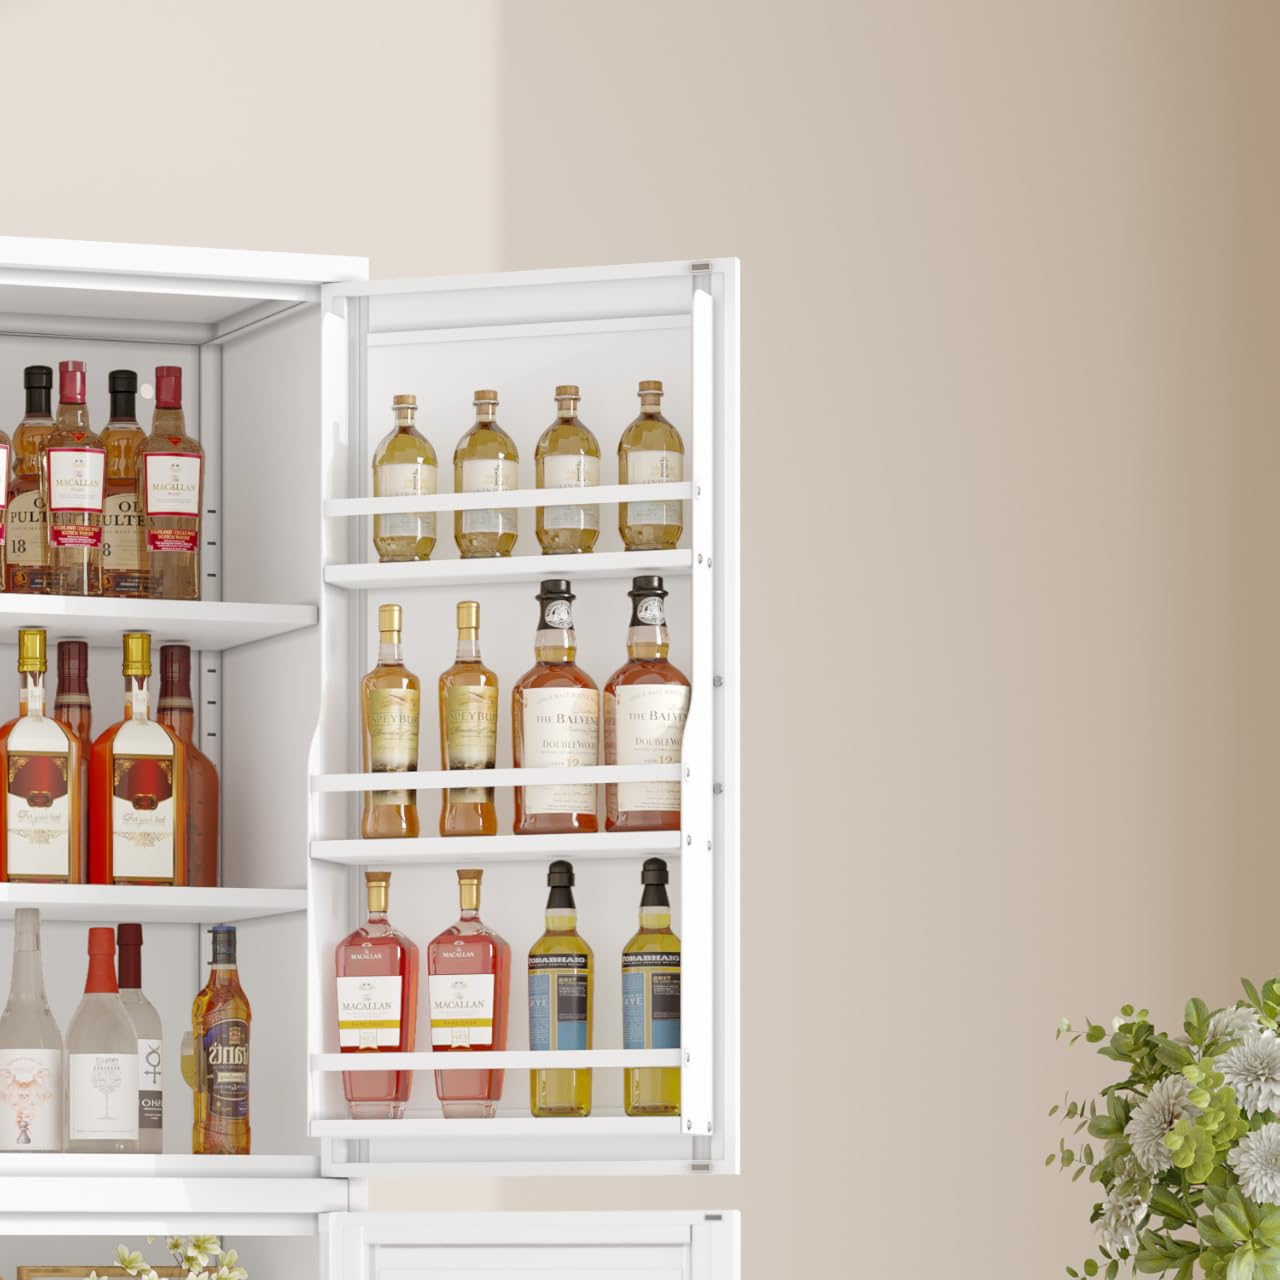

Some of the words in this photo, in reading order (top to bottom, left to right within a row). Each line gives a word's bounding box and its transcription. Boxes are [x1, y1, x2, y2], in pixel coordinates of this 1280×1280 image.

[118, 501, 144, 513] OL
[10, 511, 48, 523] PULT
[342, 1001, 392, 1011] MACALLAN
[434, 1000, 485, 1009] MACALLAN
